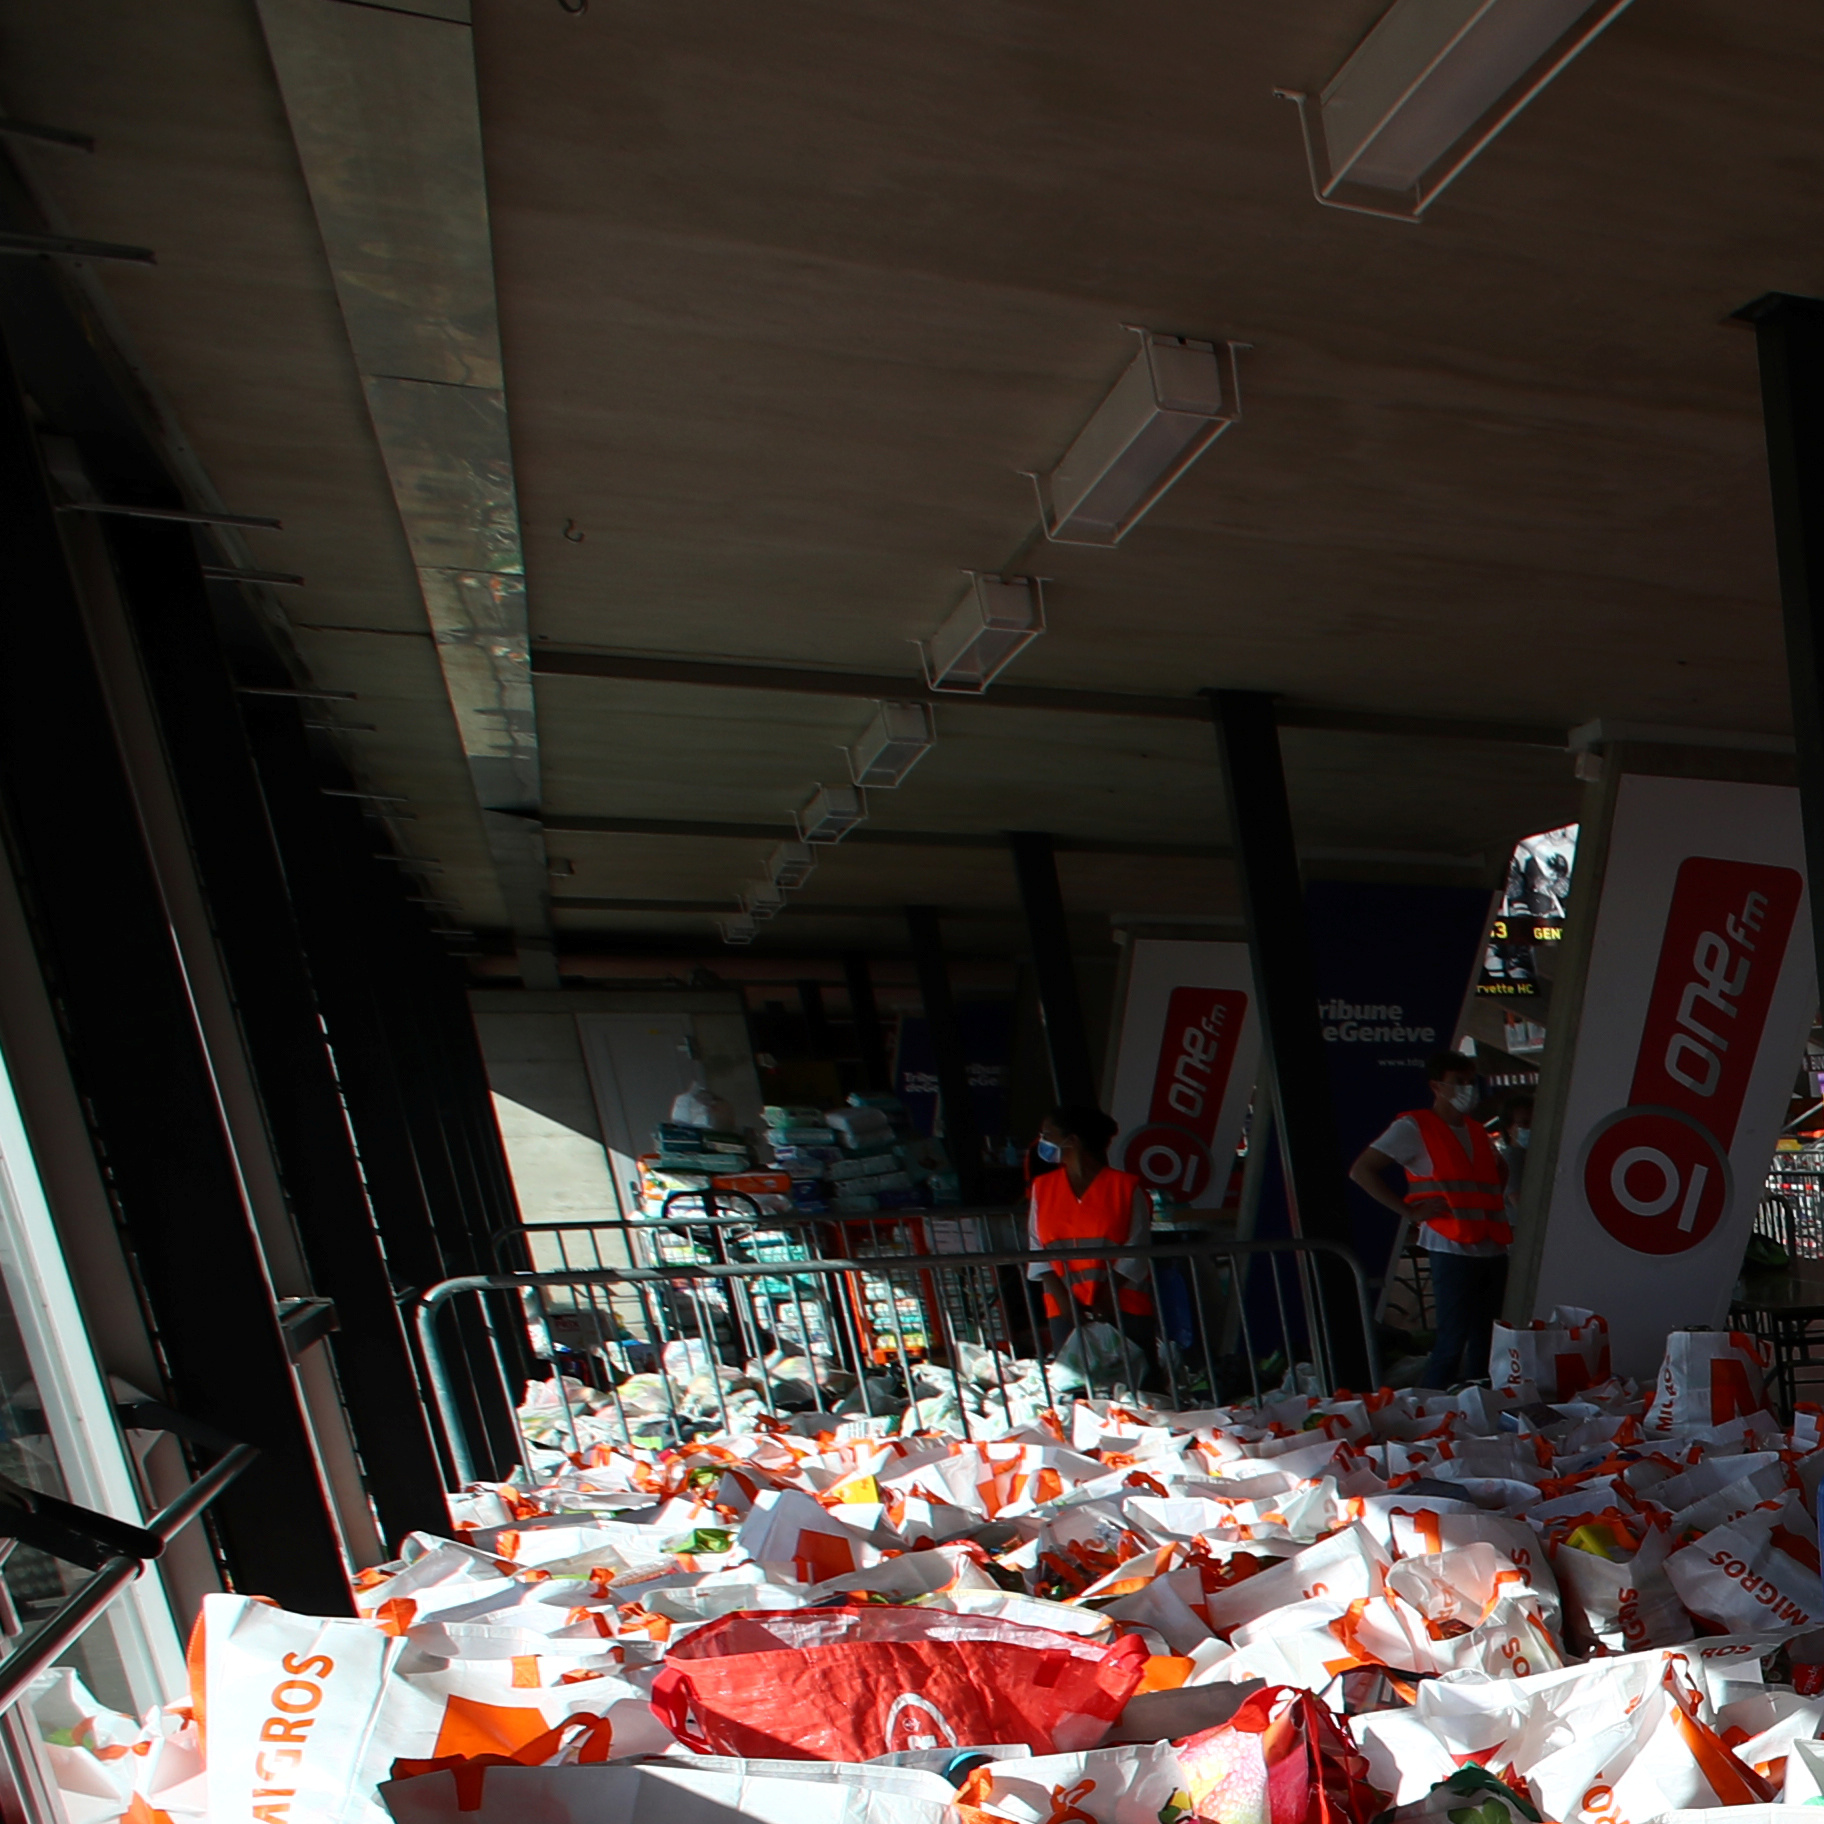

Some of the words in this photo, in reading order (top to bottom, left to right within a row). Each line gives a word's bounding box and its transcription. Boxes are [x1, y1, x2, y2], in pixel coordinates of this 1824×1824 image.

[1476, 984, 1515, 996] rvette
[1321, 1020, 1437, 1043] eGenève
[1507, 1348, 1521, 1385] ROS
[1708, 1549, 1810, 1627] MIGROS
